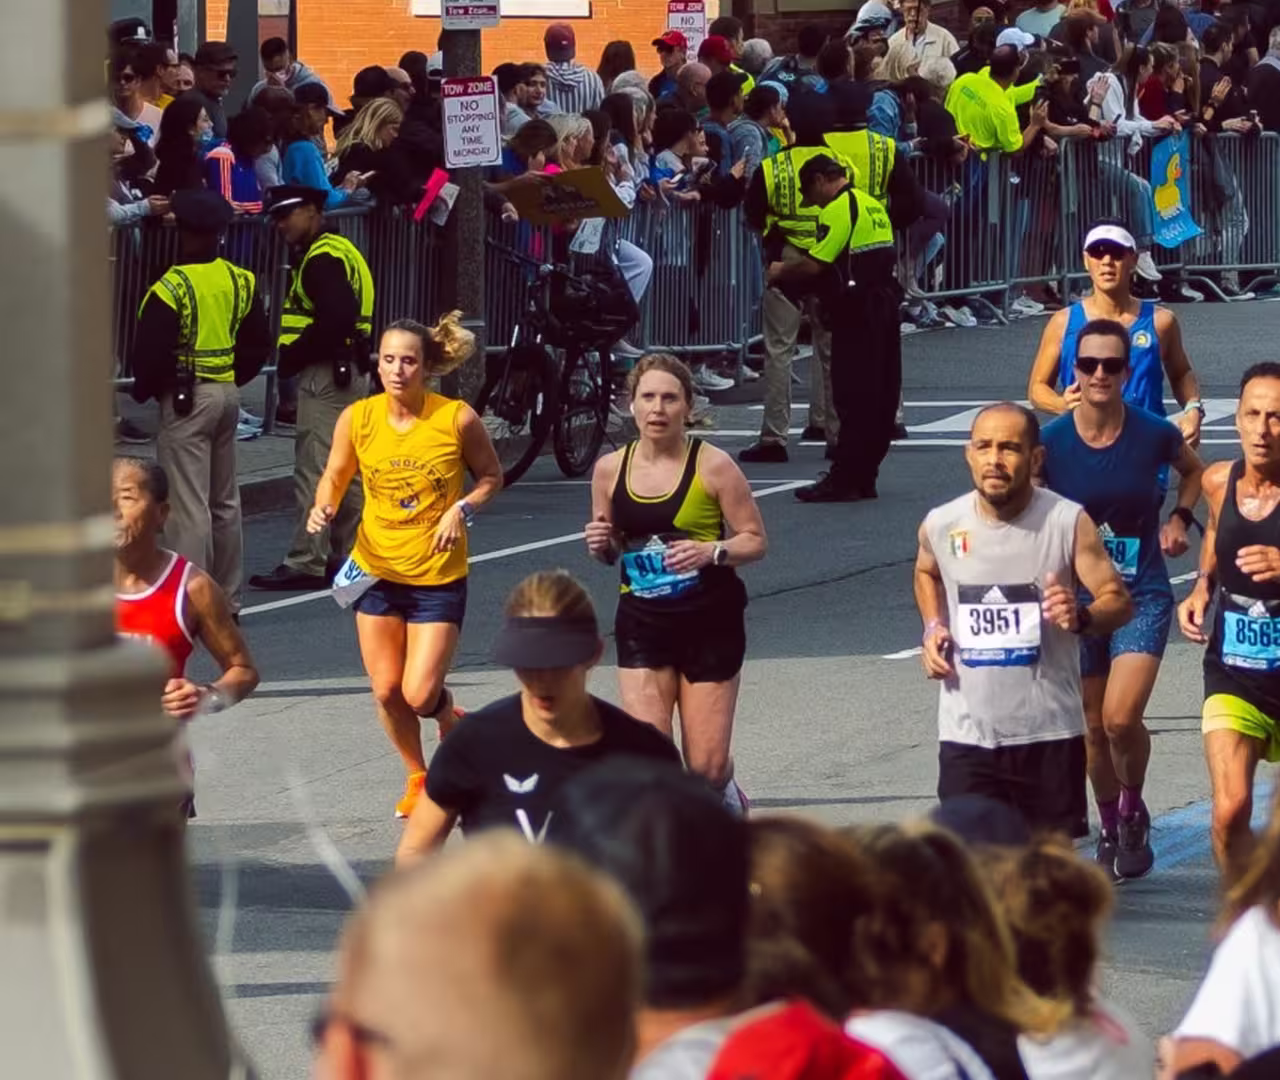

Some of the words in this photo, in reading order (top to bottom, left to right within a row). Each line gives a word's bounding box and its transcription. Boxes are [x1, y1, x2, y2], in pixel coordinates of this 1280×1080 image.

[680, 16, 696, 26] NO
[444, 84, 465, 96] TOW
[467, 81, 493, 94] ZONE
[460, 100, 479, 113] NO
[447, 112, 495, 125] STOPPING
[461, 124, 481, 135] ANY
[461, 136, 483, 145] TIME
[453, 146, 491, 158] MONDAY
[969, 606, 1021, 636] 3951
